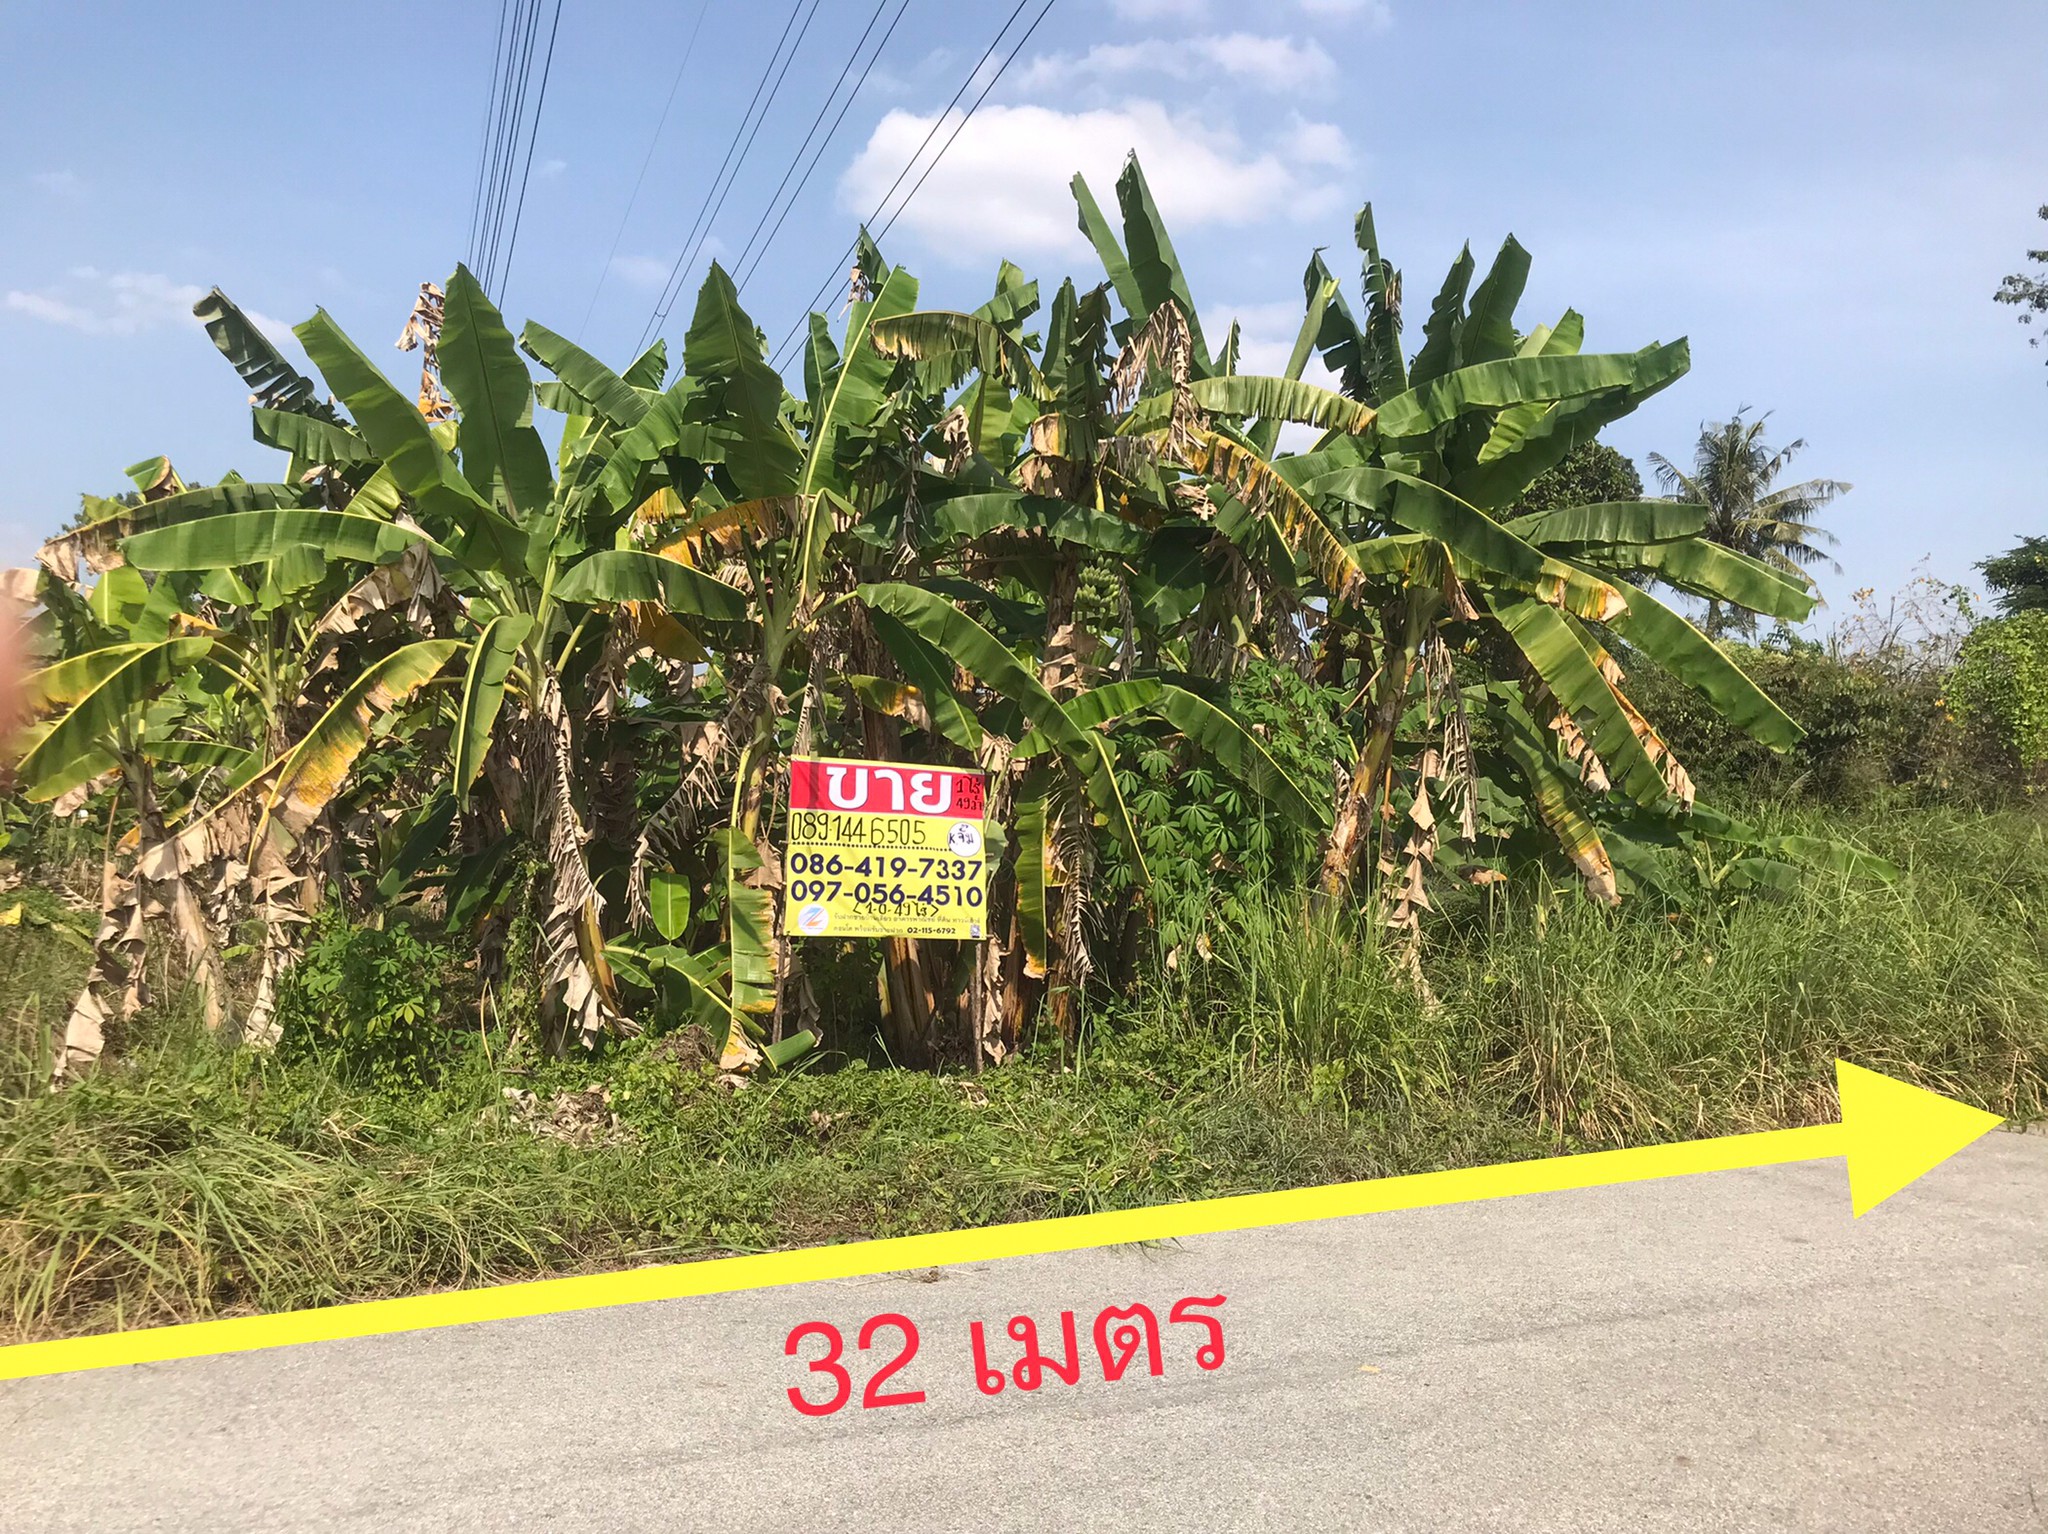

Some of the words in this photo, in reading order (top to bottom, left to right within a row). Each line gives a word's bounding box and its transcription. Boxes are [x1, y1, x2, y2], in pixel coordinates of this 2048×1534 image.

[826, 767, 952, 814] ขาย
[790, 852, 983, 881] 086-419-7337
[790, 879, 983, 908] 097-056-4510
[907, 927, 956, 935] 02-115-6792
